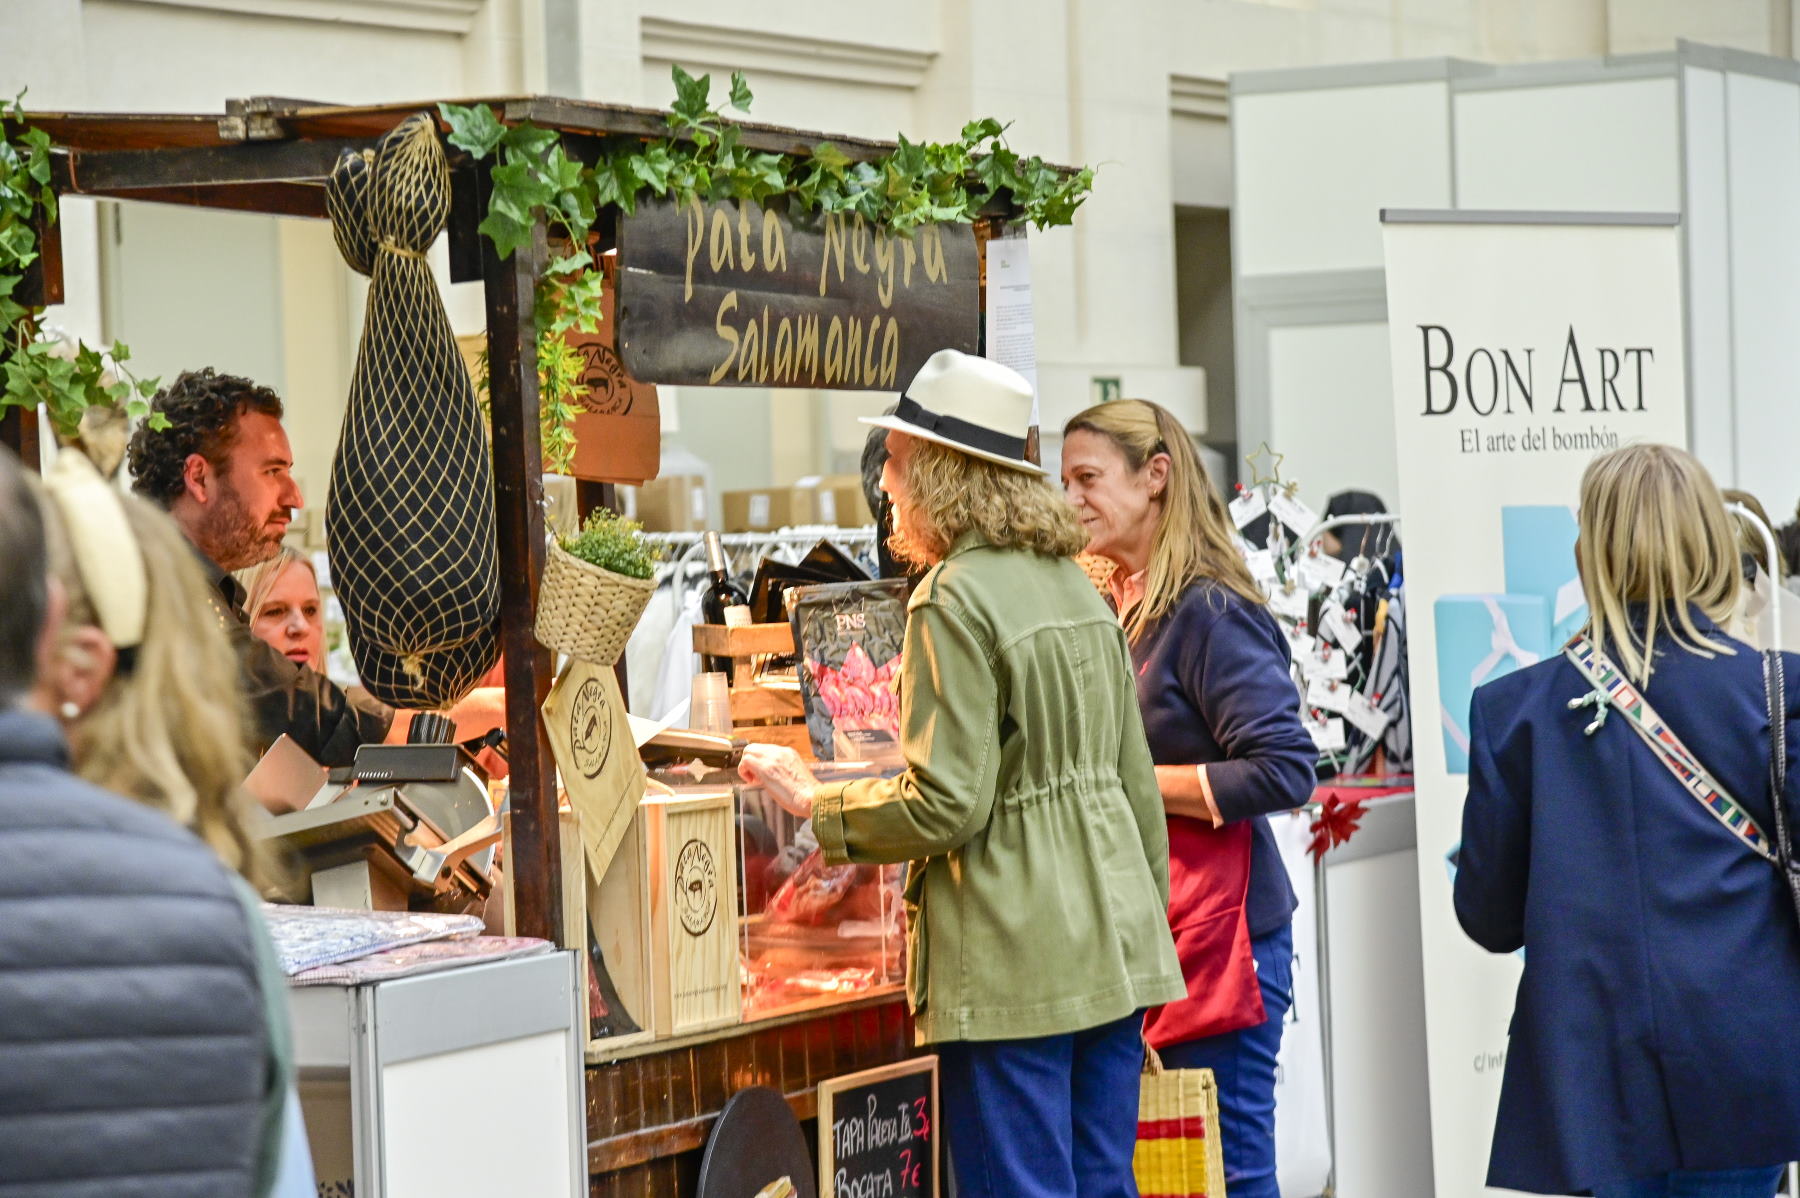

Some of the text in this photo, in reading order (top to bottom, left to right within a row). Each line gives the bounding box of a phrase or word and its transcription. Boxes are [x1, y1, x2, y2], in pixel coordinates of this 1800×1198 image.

[709, 290, 899, 390] Salamanca
[1416, 324, 1654, 416] BON ART
[1460, 425, 1619, 453] El arte del bombón
[833, 1117, 865, 1160] TAPA
[834, 1167, 893, 1198] BOCATA
